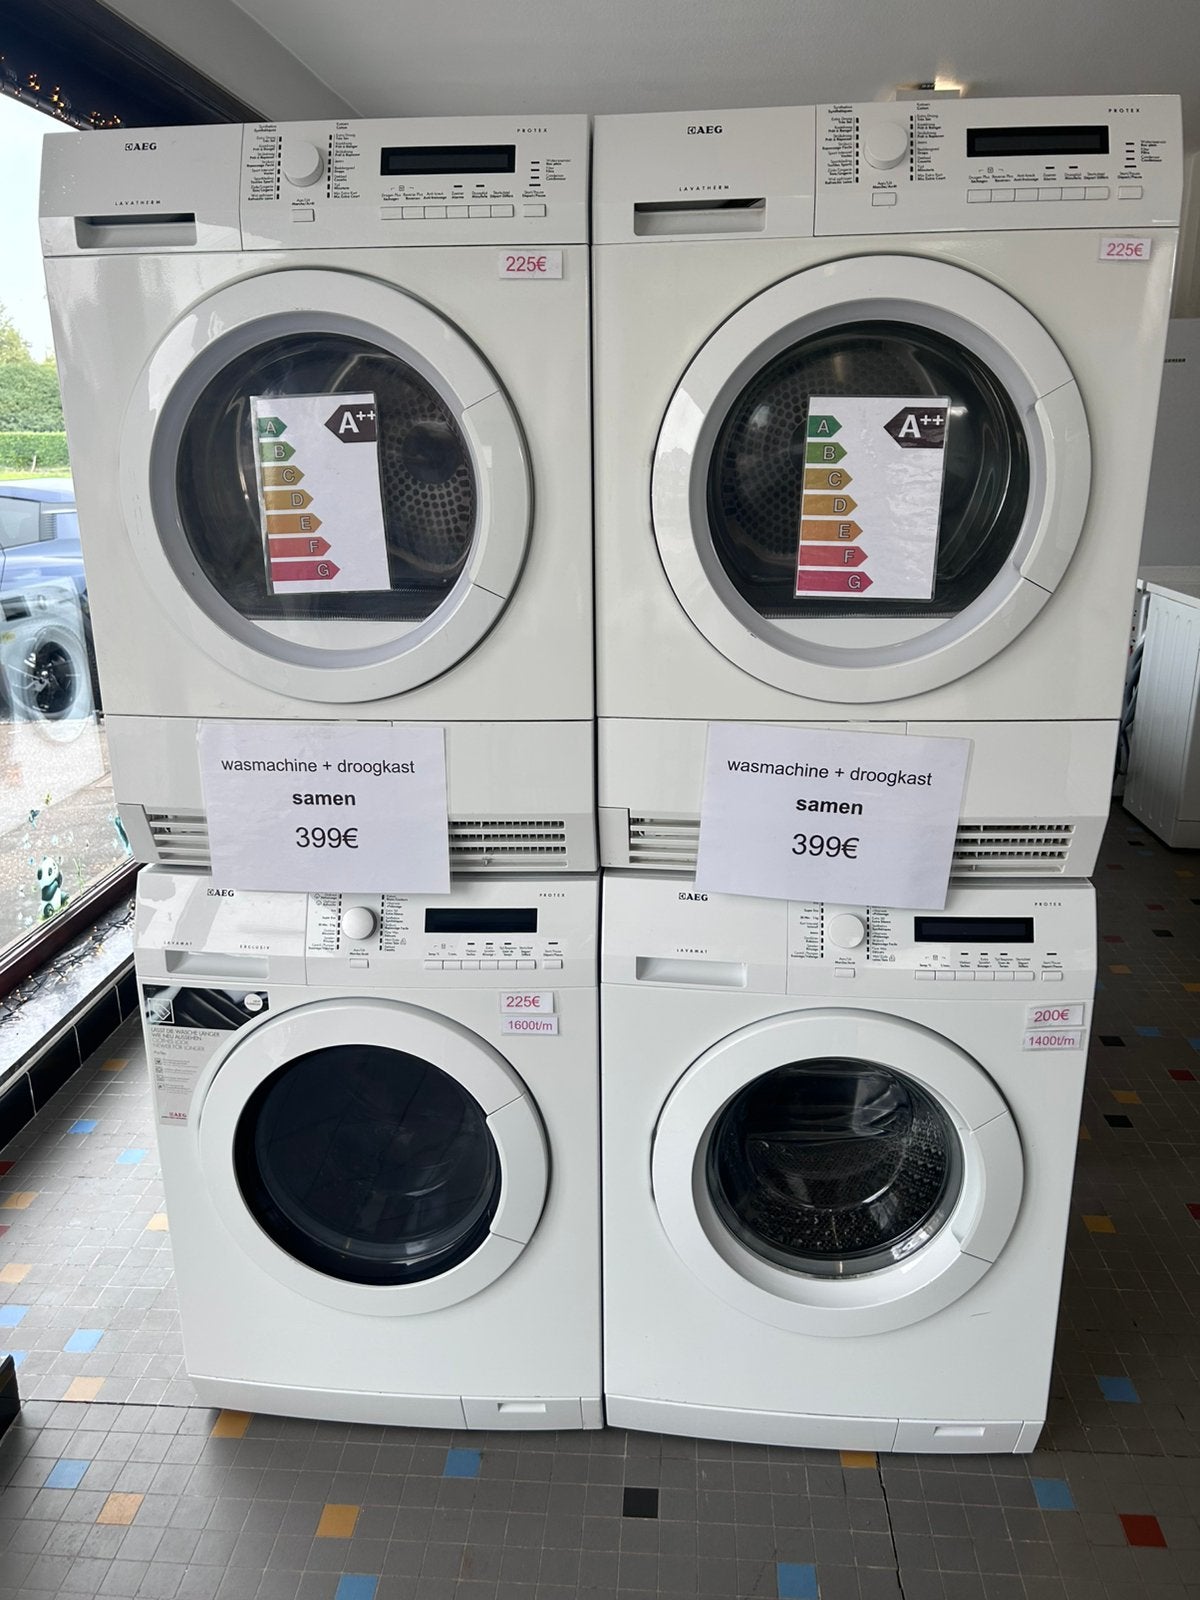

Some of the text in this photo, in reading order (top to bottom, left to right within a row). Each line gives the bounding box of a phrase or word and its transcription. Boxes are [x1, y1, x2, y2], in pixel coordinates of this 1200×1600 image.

[697, 125, 723, 135] AEG
[133, 142, 157, 151] AEG
[1106, 242, 1145, 257] 225€
[505, 255, 548, 272] 225€
[265, 420, 277, 435] A
[339, 410, 377, 434] A++
[817, 420, 830, 434] A
[898, 414, 944, 438] A++
[274, 444, 286, 459] B
[823, 445, 836, 460] B
[282, 468, 295, 483] C
[827, 472, 842, 487] C
[291, 493, 304, 507] D
[833, 498, 848, 512] D
[300, 516, 312, 530] E
[838, 524, 851, 538] E
[309, 539, 319, 553] F
[844, 549, 855, 564] F
[317, 563, 330, 577] G
[847, 574, 861, 589] G
[221, 758, 416, 777] wasmachine + droogkast
[727, 760, 932, 787] wasmachine + droogkast
[292, 793, 356, 806] samen
[796, 798, 863, 815] samen
[295, 826, 359, 848] 399€
[791, 834, 860, 859] 399€
[214, 888, 235, 897] AEG
[686, 893, 709, 902] AEG
[506, 995, 541, 1008] 225€
[1034, 1008, 1070, 1023] 200€
[508, 1020, 553, 1031] 1600t/m
[1028, 1035, 1075, 1047] 1400t/m
